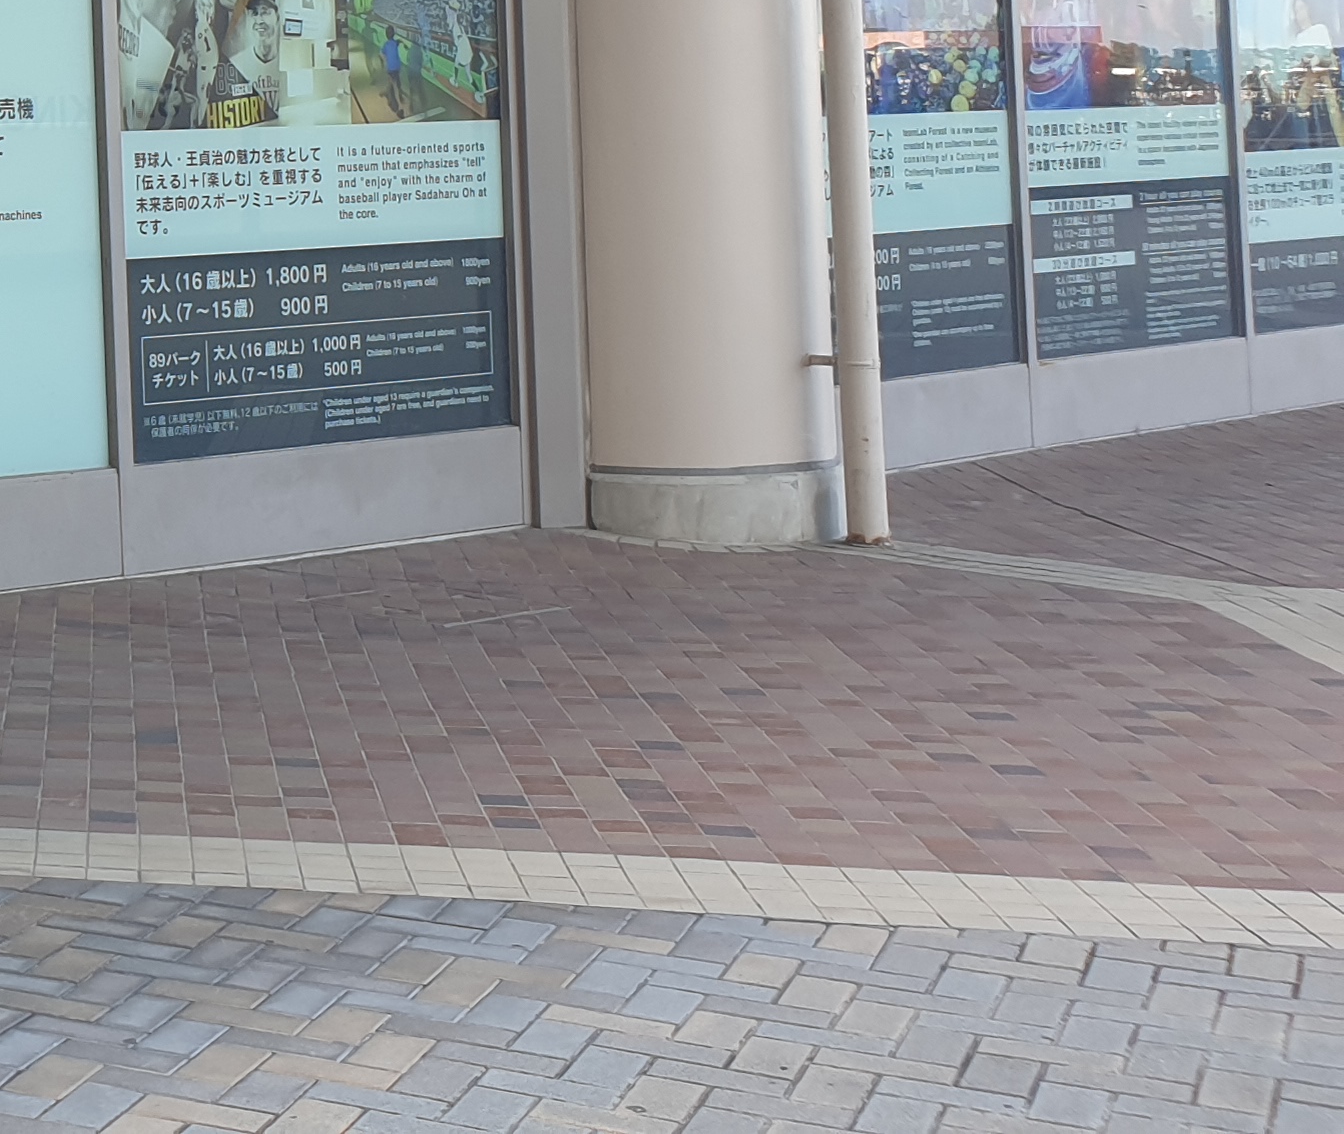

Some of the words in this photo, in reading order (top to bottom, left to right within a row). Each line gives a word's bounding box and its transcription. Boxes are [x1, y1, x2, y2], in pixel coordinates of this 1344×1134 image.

[207, 96, 266, 128] HISTORY
[337, 146, 344, 157] It
[348, 146, 357, 156] is
[361, 147, 367, 156] a
[370, 143, 449, 156] future-oriented
[452, 142, 485, 154] sports
[337, 163, 379, 173] museum
[381, 160, 401, 171] that
[403, 158, 459, 171] emphasizes
[338, 177, 357, 188] and
[400, 175, 422, 186] with
[425, 174, 441, 185] the
[443, 173, 474, 184] charm
[476, 171, 487, 182] of
[136, 190, 323, 213] 未来志向のスポーツミュージアム
[338, 192, 379, 204] baseball
[382, 192, 412, 205] player
[415, 189, 459, 201] Sadaharu
[462, 187, 476, 198] Oh
[478, 187, 487, 197] at
[339, 209, 354, 220] the
[355, 209, 379, 219] core.
[137, 219, 169, 235] です。
[341, 264, 366, 273] Adults
[415, 259, 428, 268] and
[342, 282, 373, 292] Children
[383, 280, 391, 289] to
[403, 278, 423, 289] years
[152, 369, 199, 389] チケット
